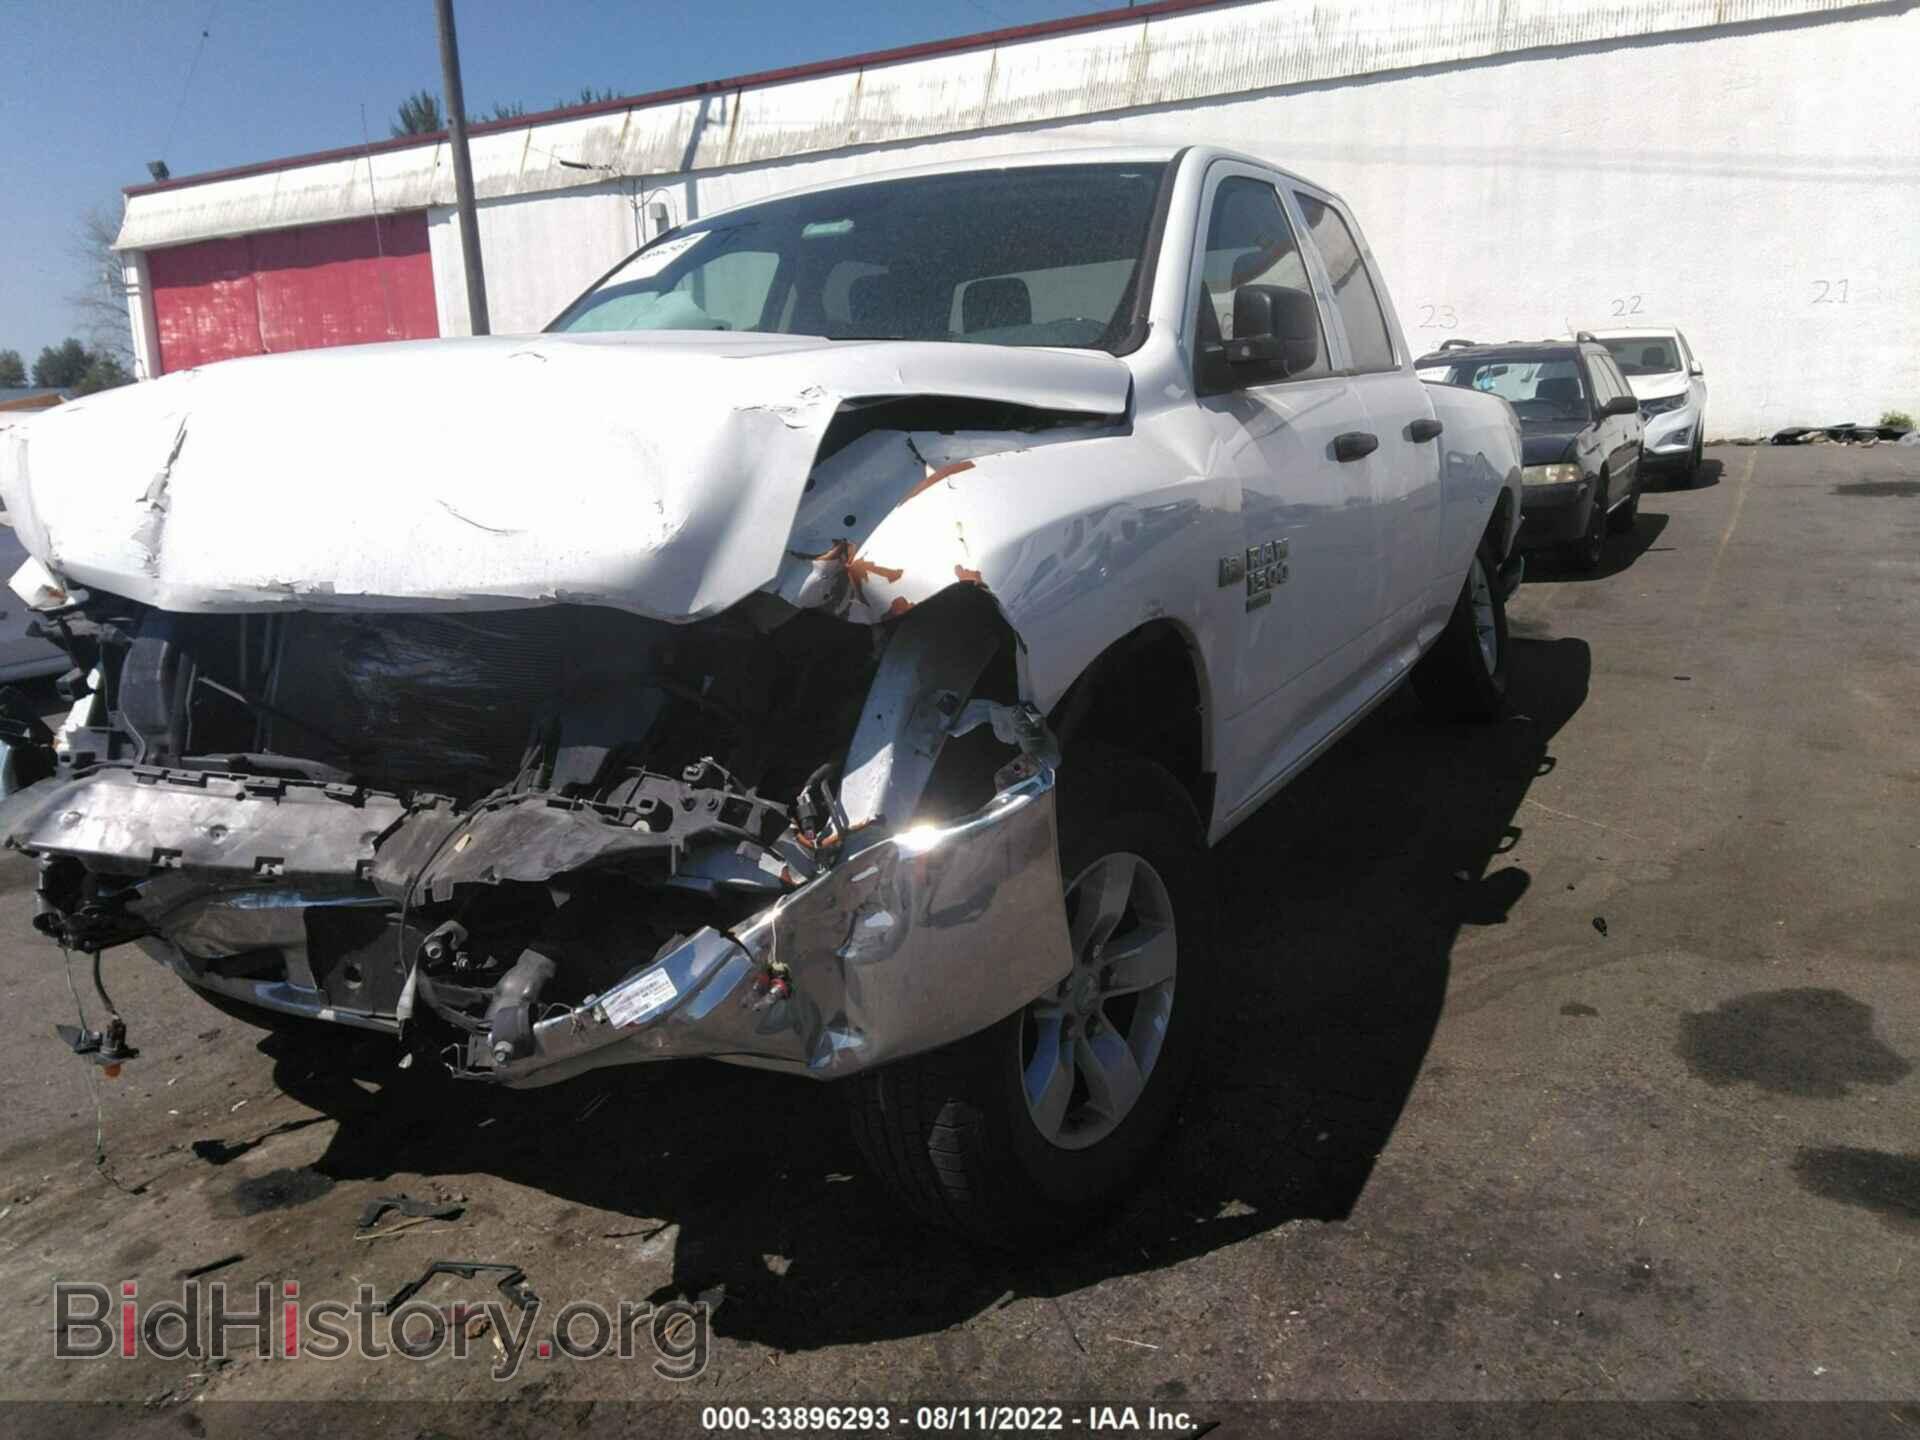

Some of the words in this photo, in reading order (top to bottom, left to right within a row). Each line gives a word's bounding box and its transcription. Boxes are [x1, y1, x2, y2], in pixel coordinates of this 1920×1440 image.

[1809, 278, 1849, 304] 21
[1419, 304, 1458, 329] 23
[1611, 295, 1645, 317] 22
